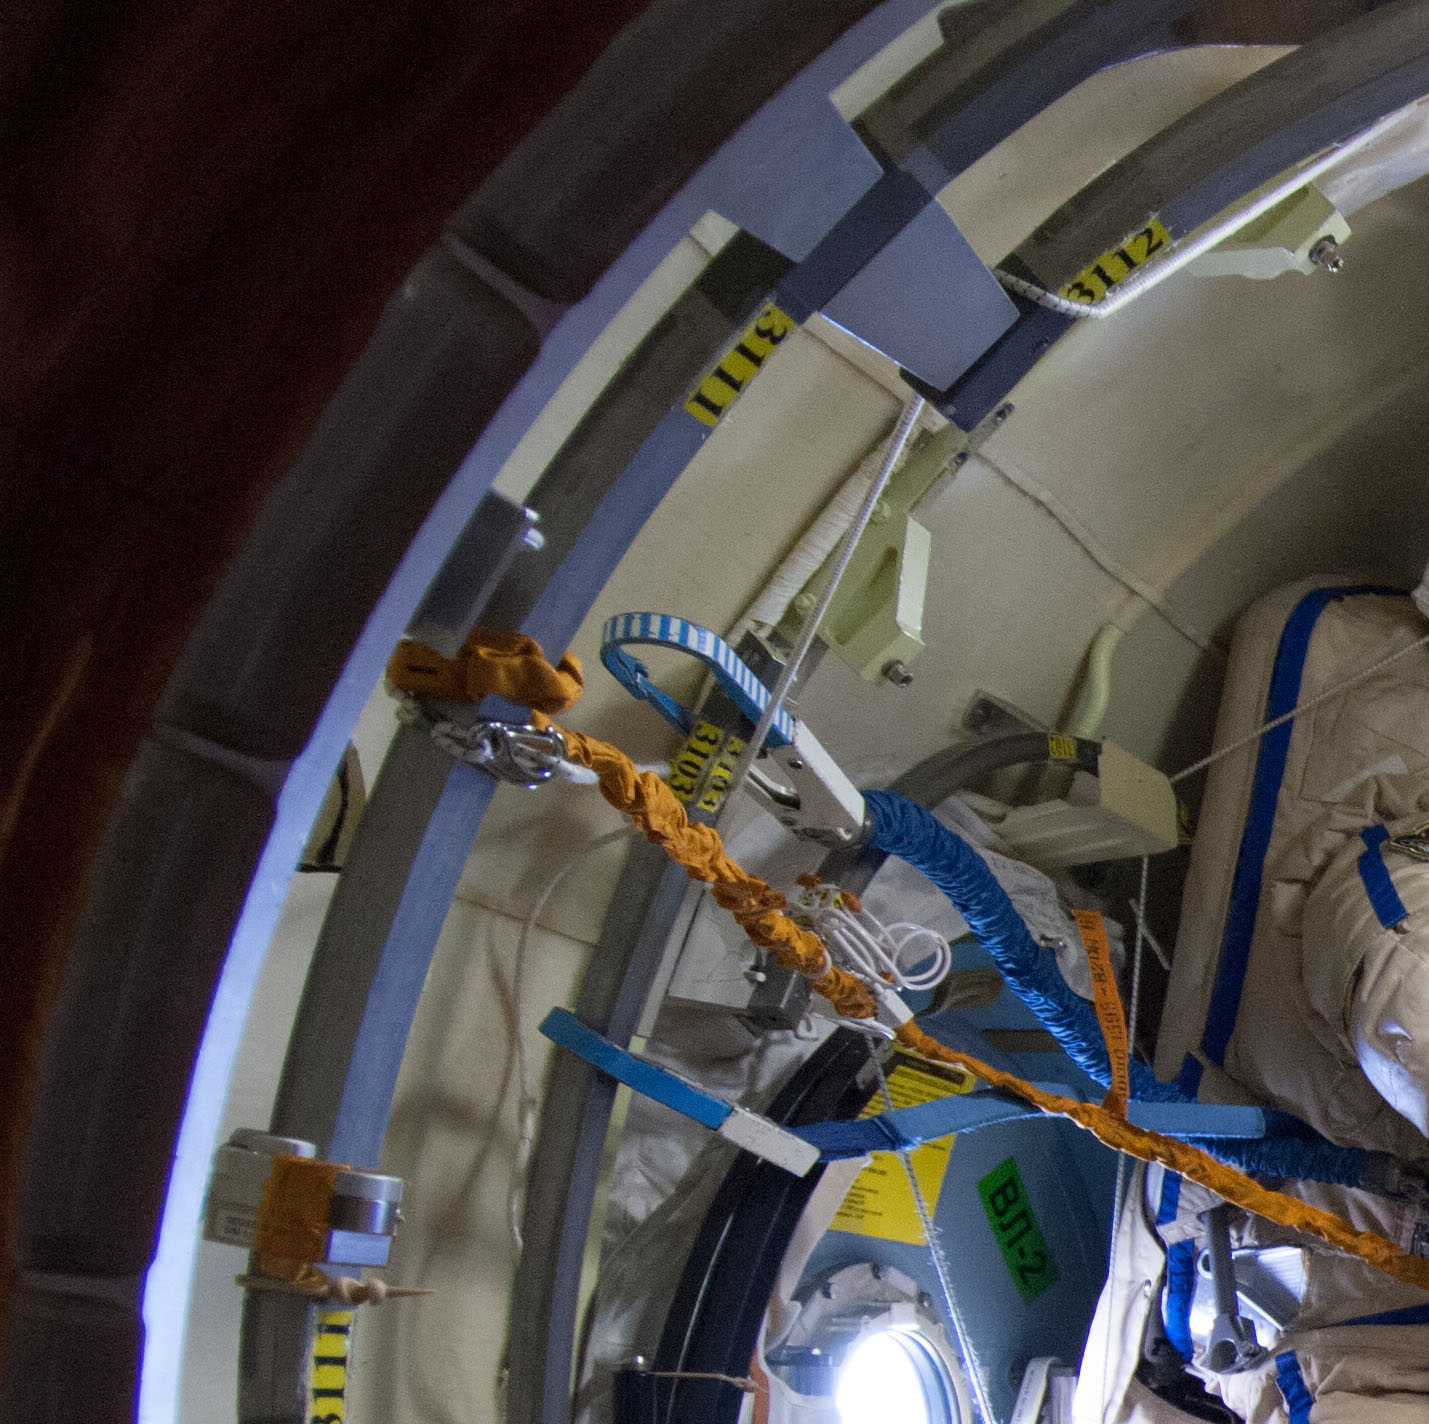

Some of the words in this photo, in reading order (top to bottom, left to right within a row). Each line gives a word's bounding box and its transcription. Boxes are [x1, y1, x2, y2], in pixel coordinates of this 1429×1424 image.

[1068, 229, 1164, 303] 3112
[693, 309, 788, 418] 3111
[671, 726, 721, 795] 3103
[989, 1176, 1047, 1286] ВП-2
